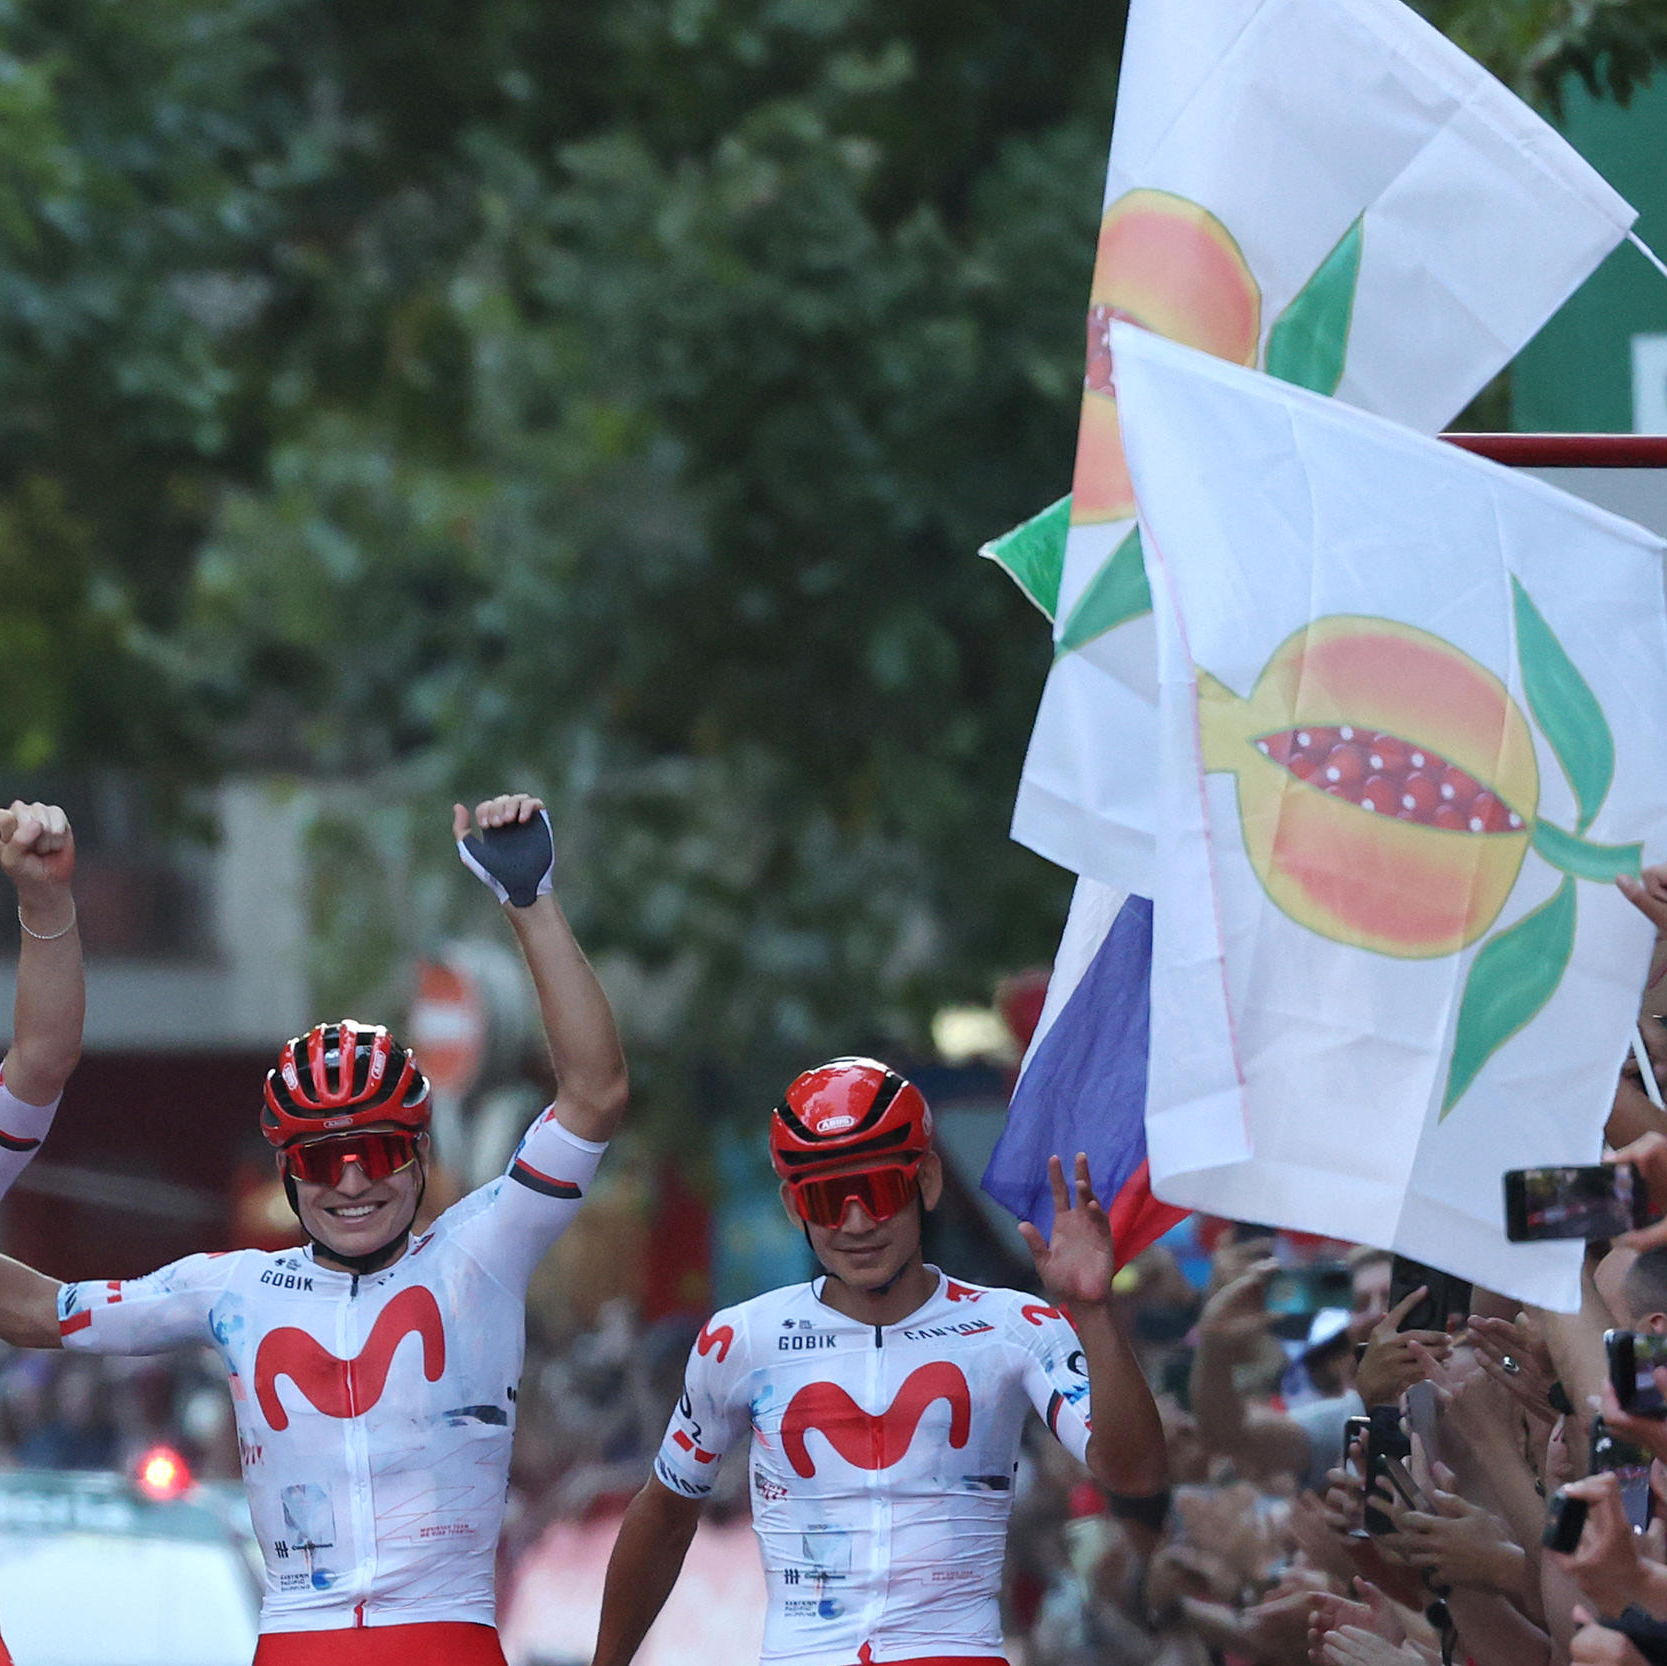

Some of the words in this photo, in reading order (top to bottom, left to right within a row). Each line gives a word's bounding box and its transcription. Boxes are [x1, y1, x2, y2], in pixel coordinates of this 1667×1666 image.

[260, 1269, 314, 1292] GOBIK
[903, 1318, 989, 1341] CANYON
[778, 1335, 837, 1351] GOBIK
